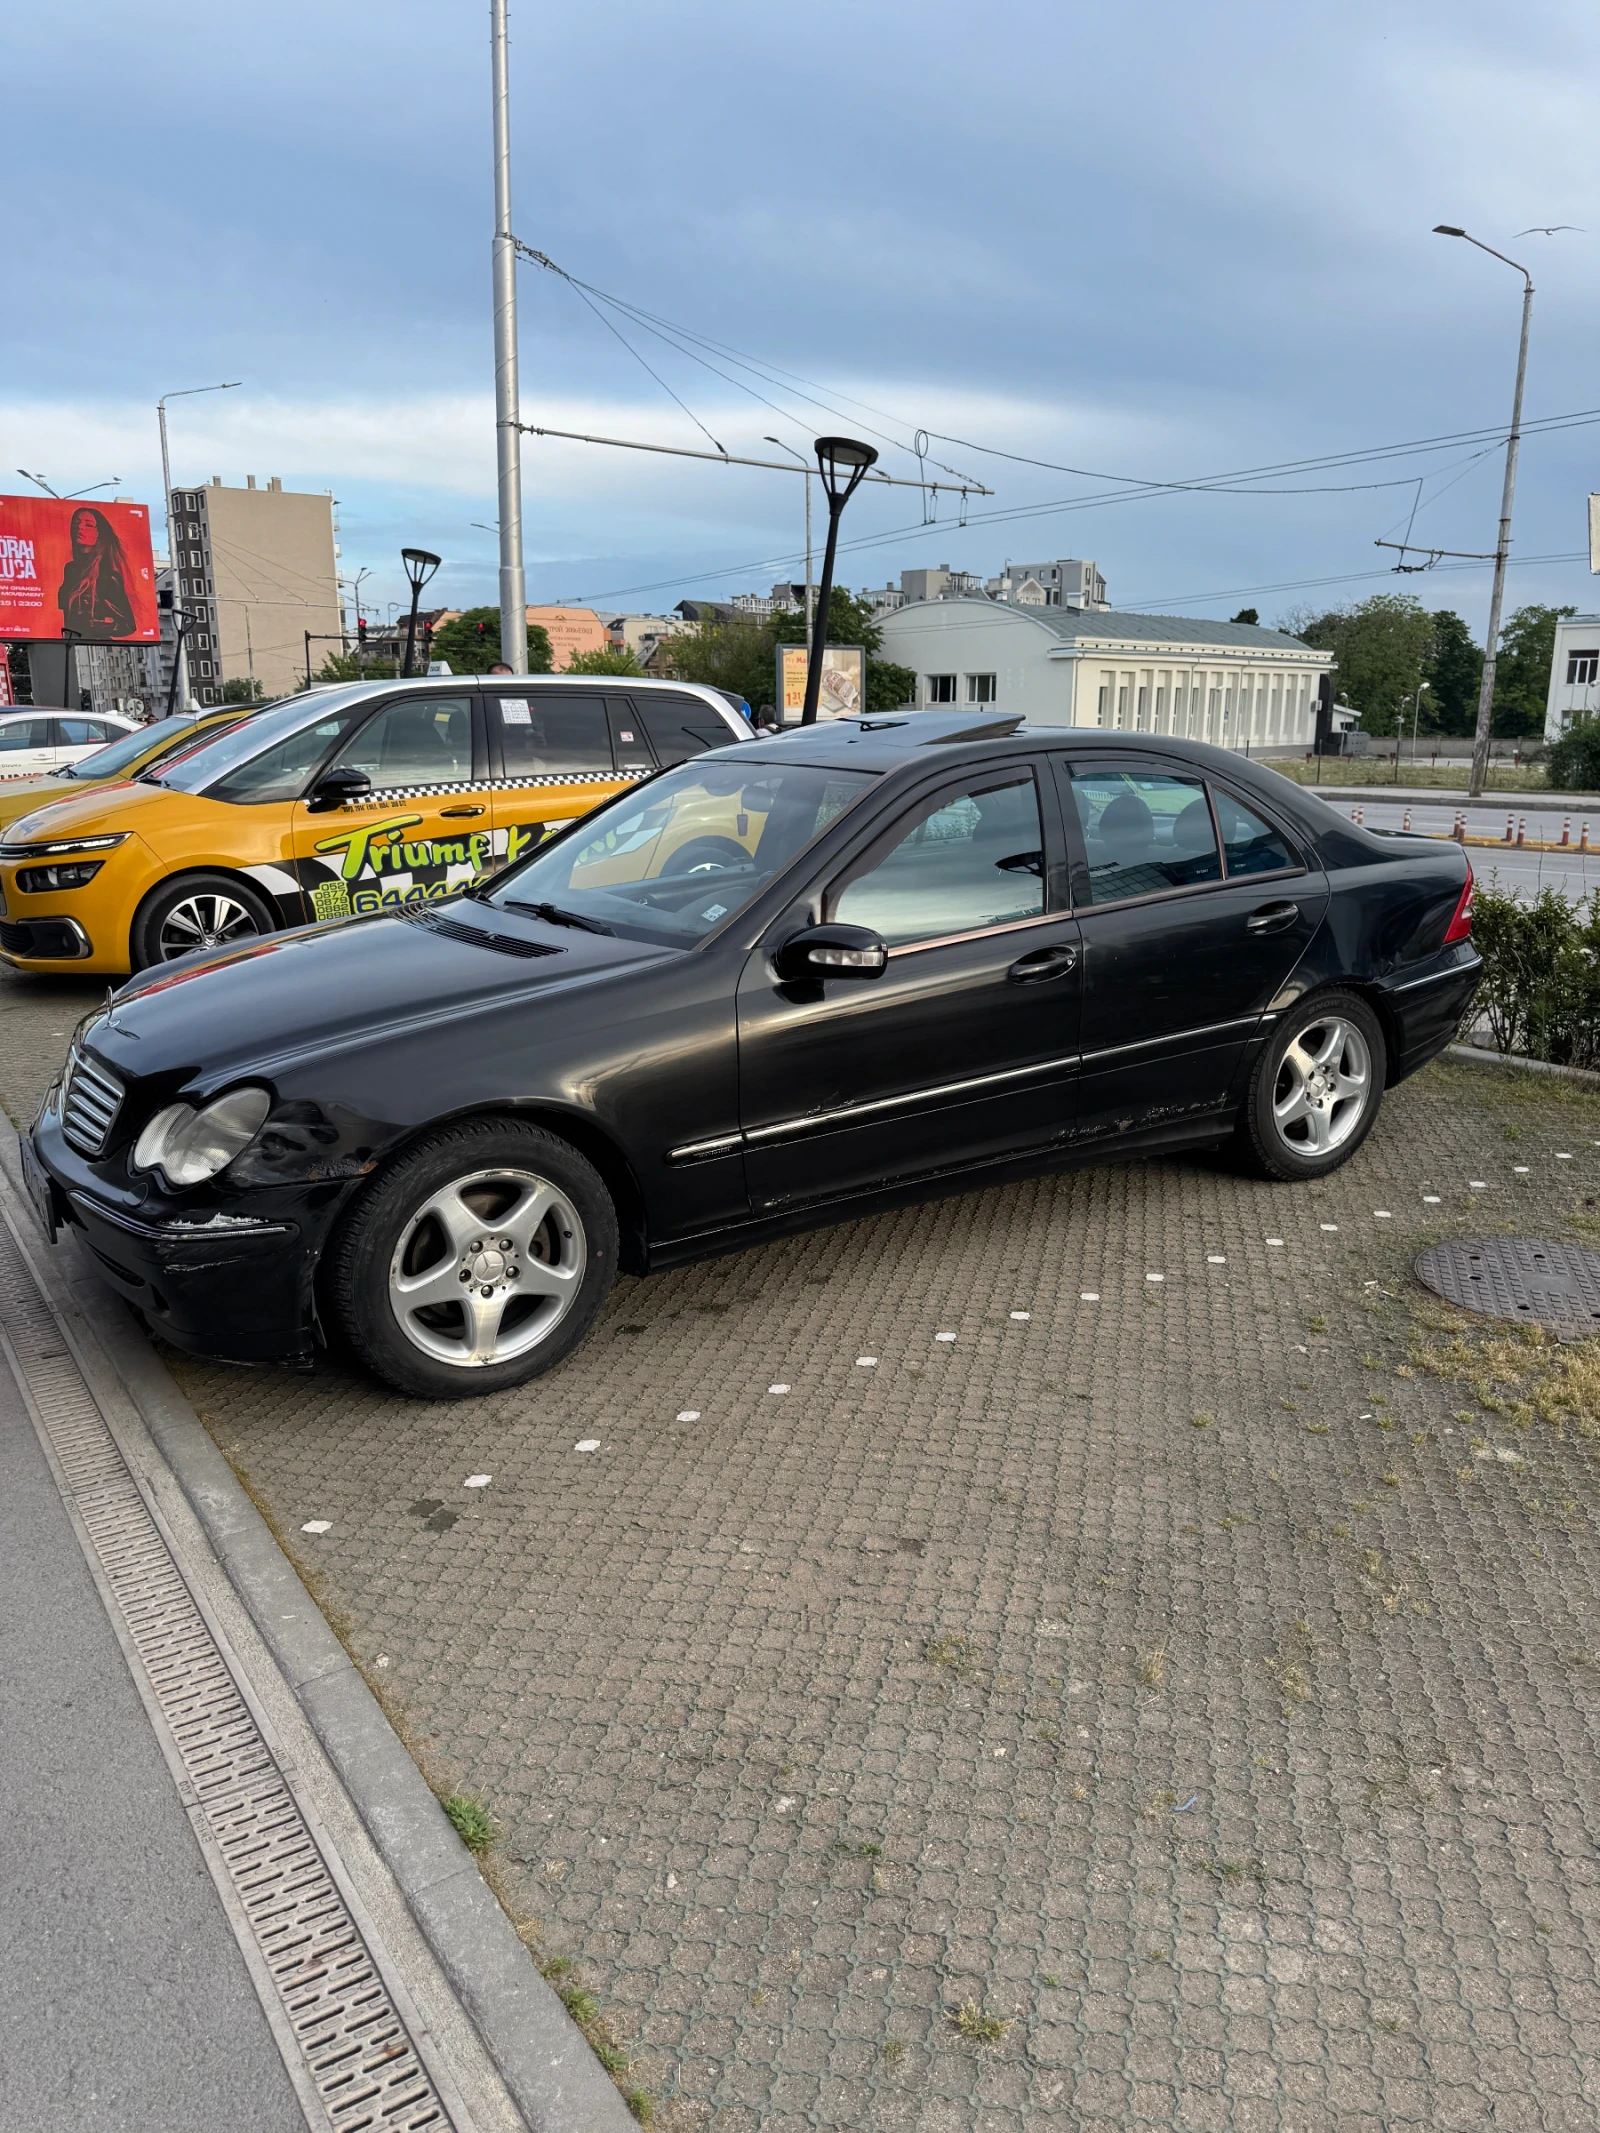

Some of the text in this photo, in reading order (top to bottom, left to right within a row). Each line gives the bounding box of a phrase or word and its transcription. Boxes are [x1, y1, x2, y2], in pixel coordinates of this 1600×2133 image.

[314, 813, 490, 881] Triumf
[321, 881, 346, 891] 052
[315, 889, 346, 899] 0877
[316, 896, 348, 907] 0879
[317, 903, 349, 914] 0882
